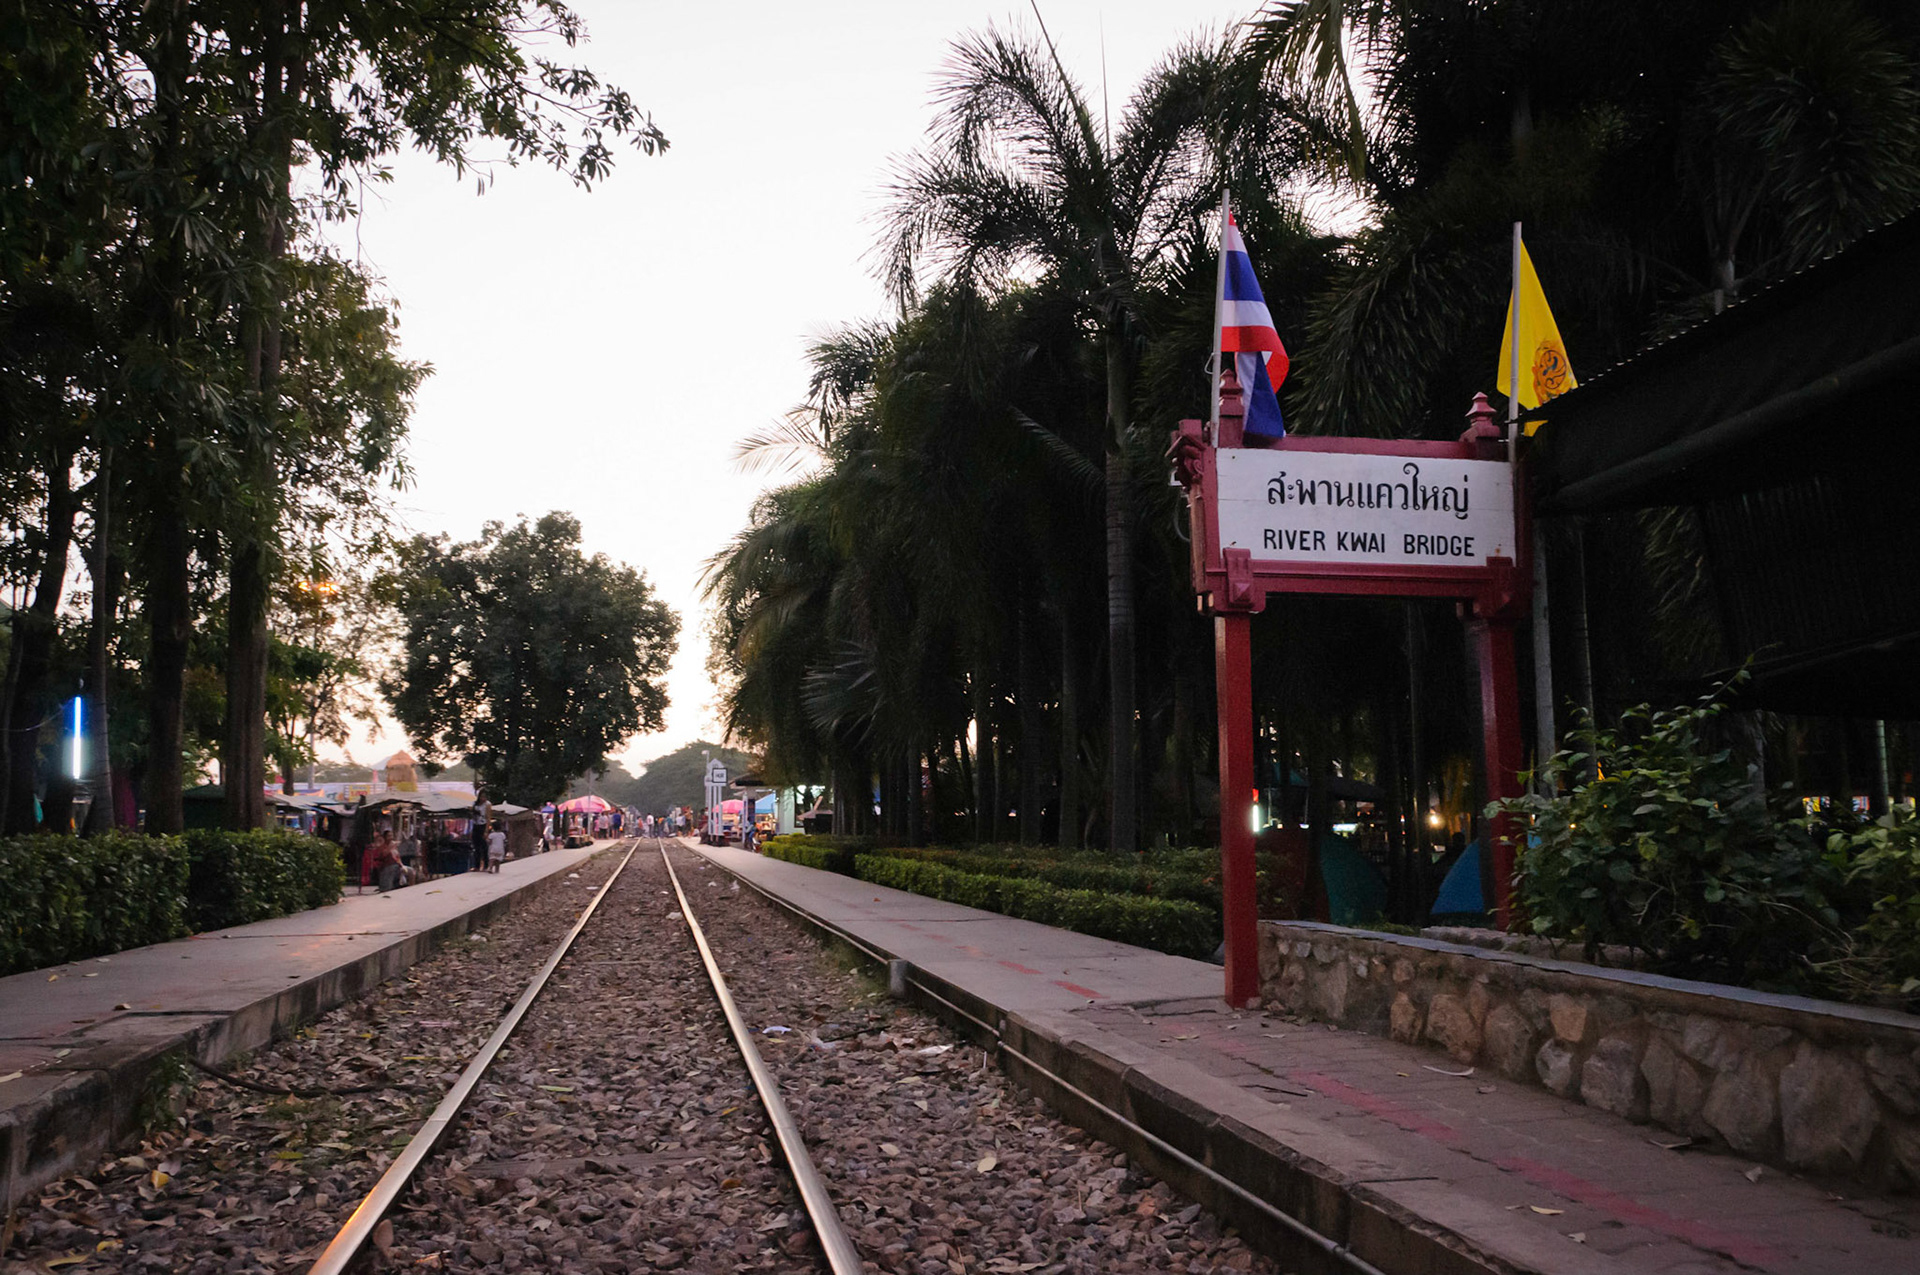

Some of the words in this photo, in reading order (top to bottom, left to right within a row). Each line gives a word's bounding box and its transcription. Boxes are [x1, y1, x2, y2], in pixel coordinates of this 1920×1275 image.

[1267, 462, 1469, 520] สะพานแควใหญ่
[1263, 528, 1326, 552] RIVER
[1337, 530, 1386, 554] KWAI
[1403, 533, 1476, 558] BRIDGE
